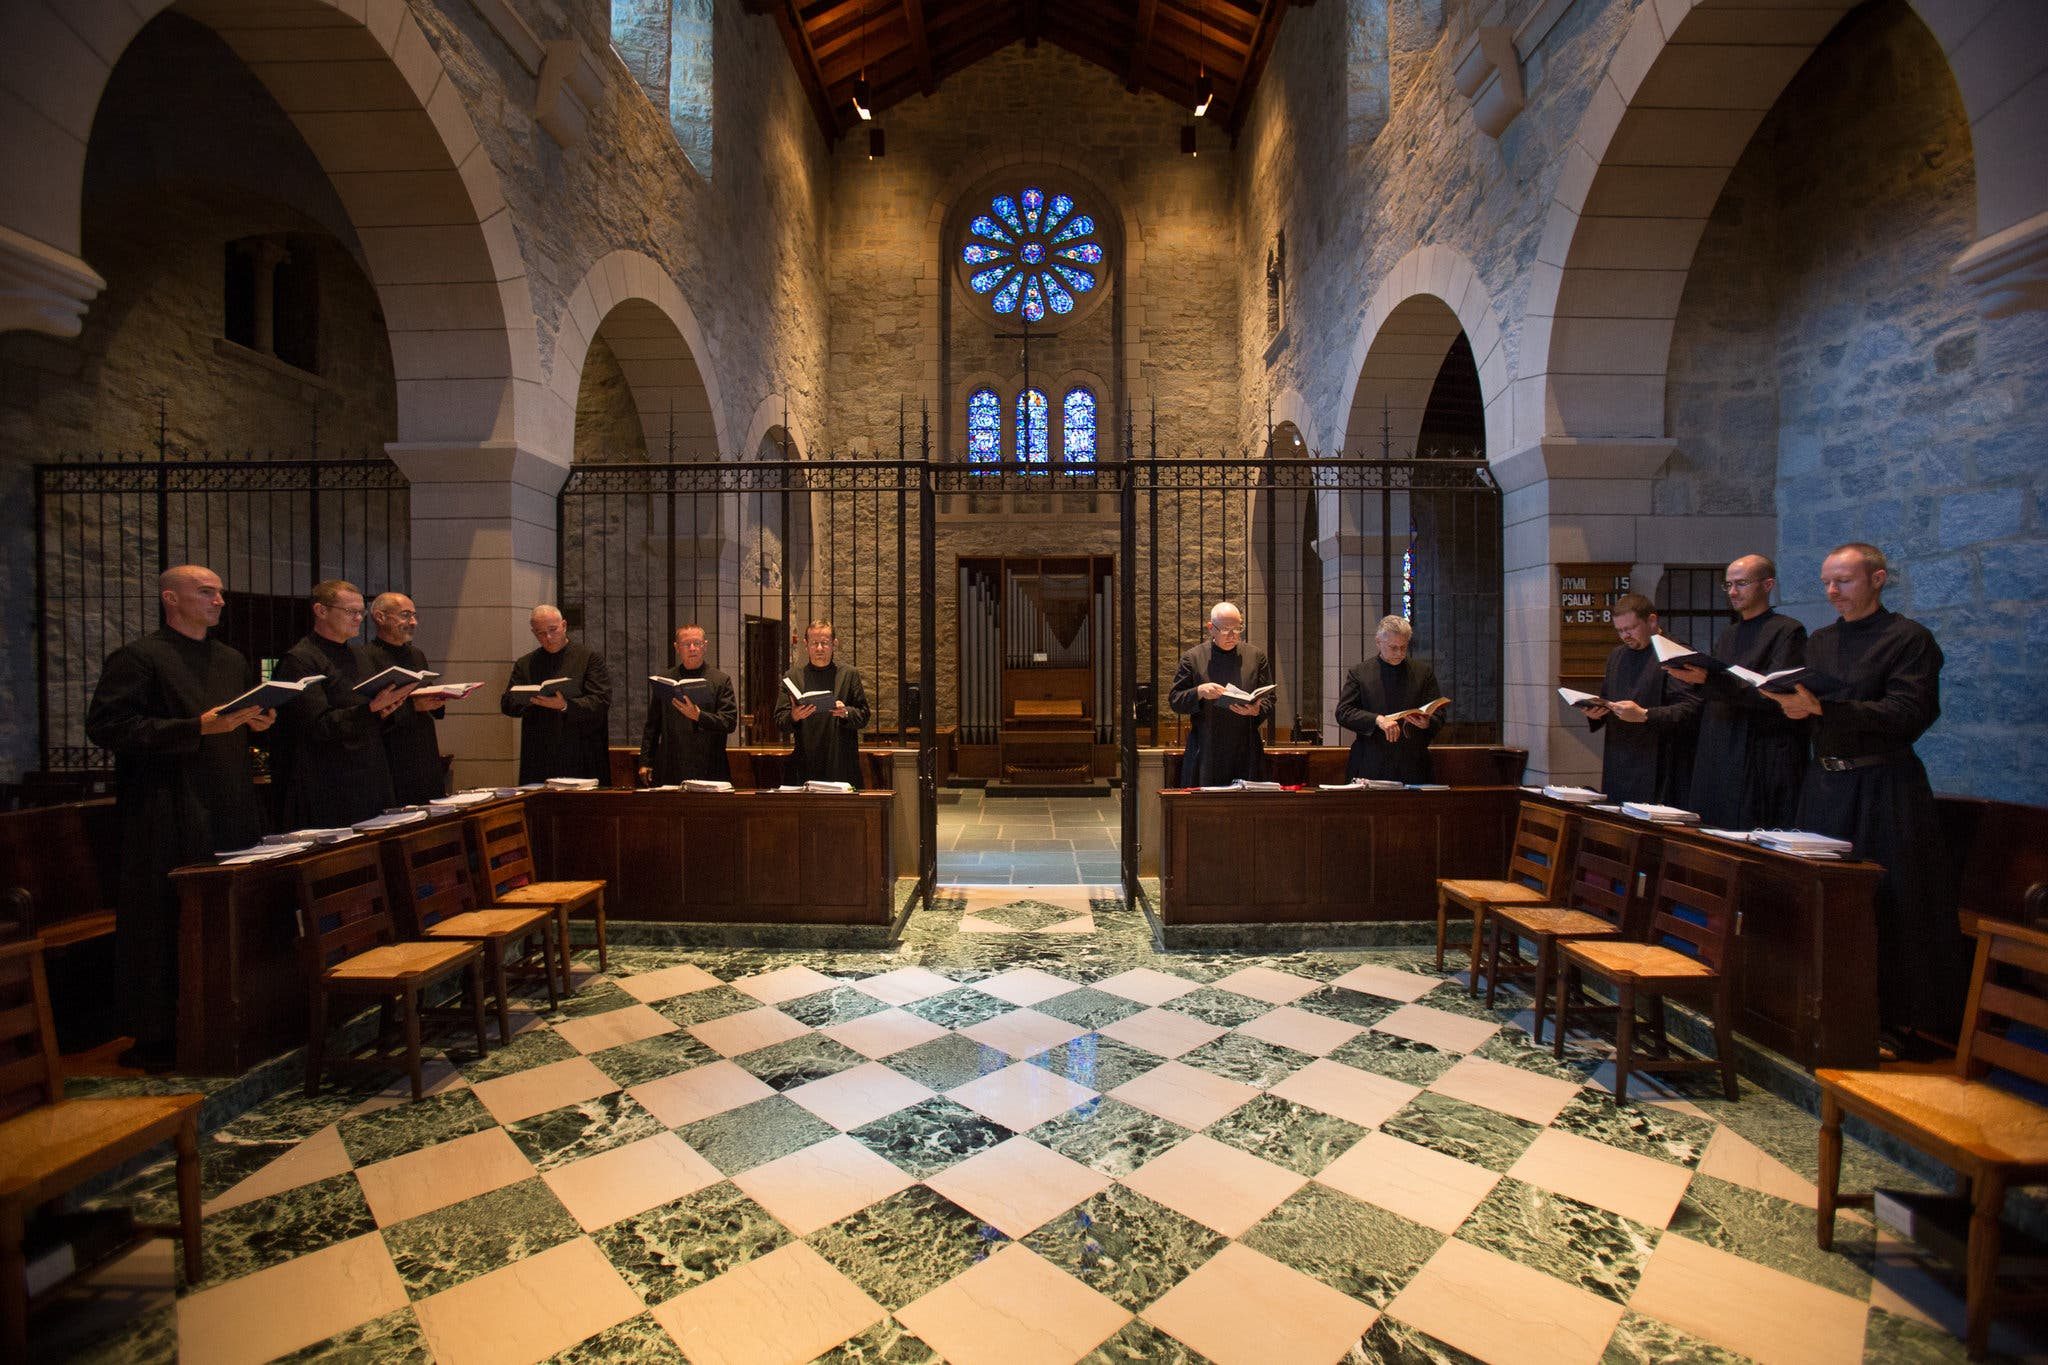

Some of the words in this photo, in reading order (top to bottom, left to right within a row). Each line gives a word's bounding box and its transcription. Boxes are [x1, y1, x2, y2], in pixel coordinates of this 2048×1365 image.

[1562, 578, 1586, 590] HYMN
[1615, 577, 1629, 589] 15
[1562, 593, 1595, 606] PSALM:
[1606, 593, 1629, 606] 11
